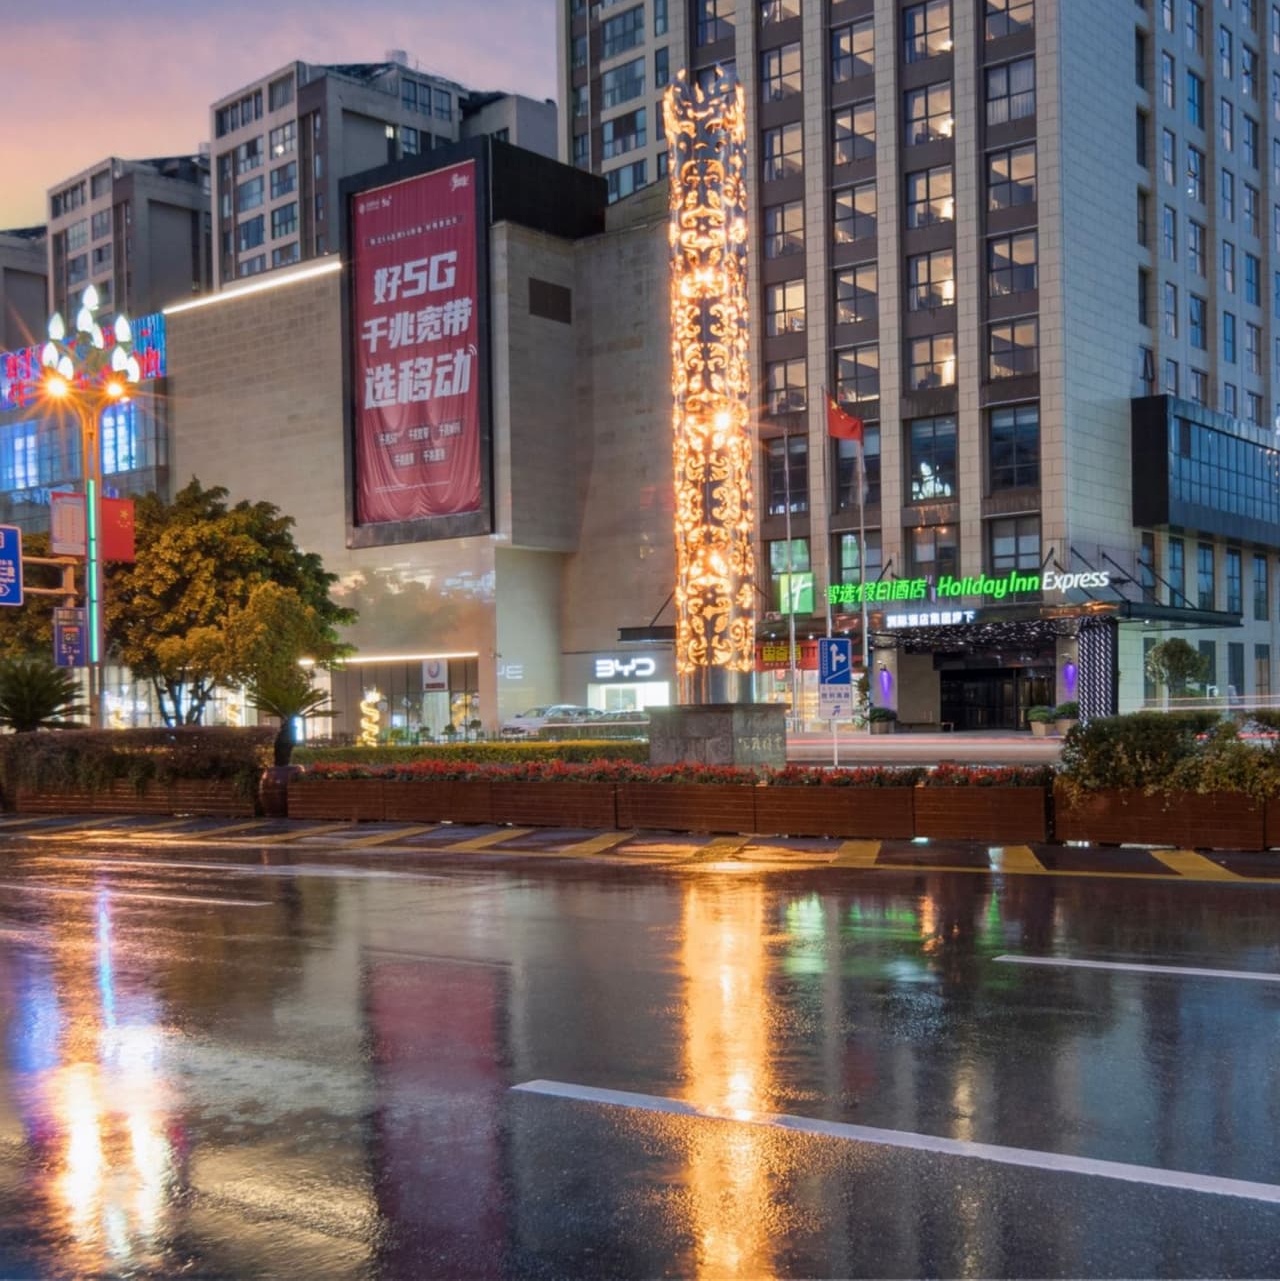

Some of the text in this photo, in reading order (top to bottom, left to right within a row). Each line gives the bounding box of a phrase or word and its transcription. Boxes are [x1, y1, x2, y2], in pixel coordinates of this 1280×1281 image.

[373, 250, 458, 305] 好5G
[361, 296, 473, 353] 千兆宽带
[365, 347, 471, 409] 选移动
[824, 570, 1110, 605] 智选假日酒店 Holiday Inn Express
[595, 657, 656, 679] BYD
